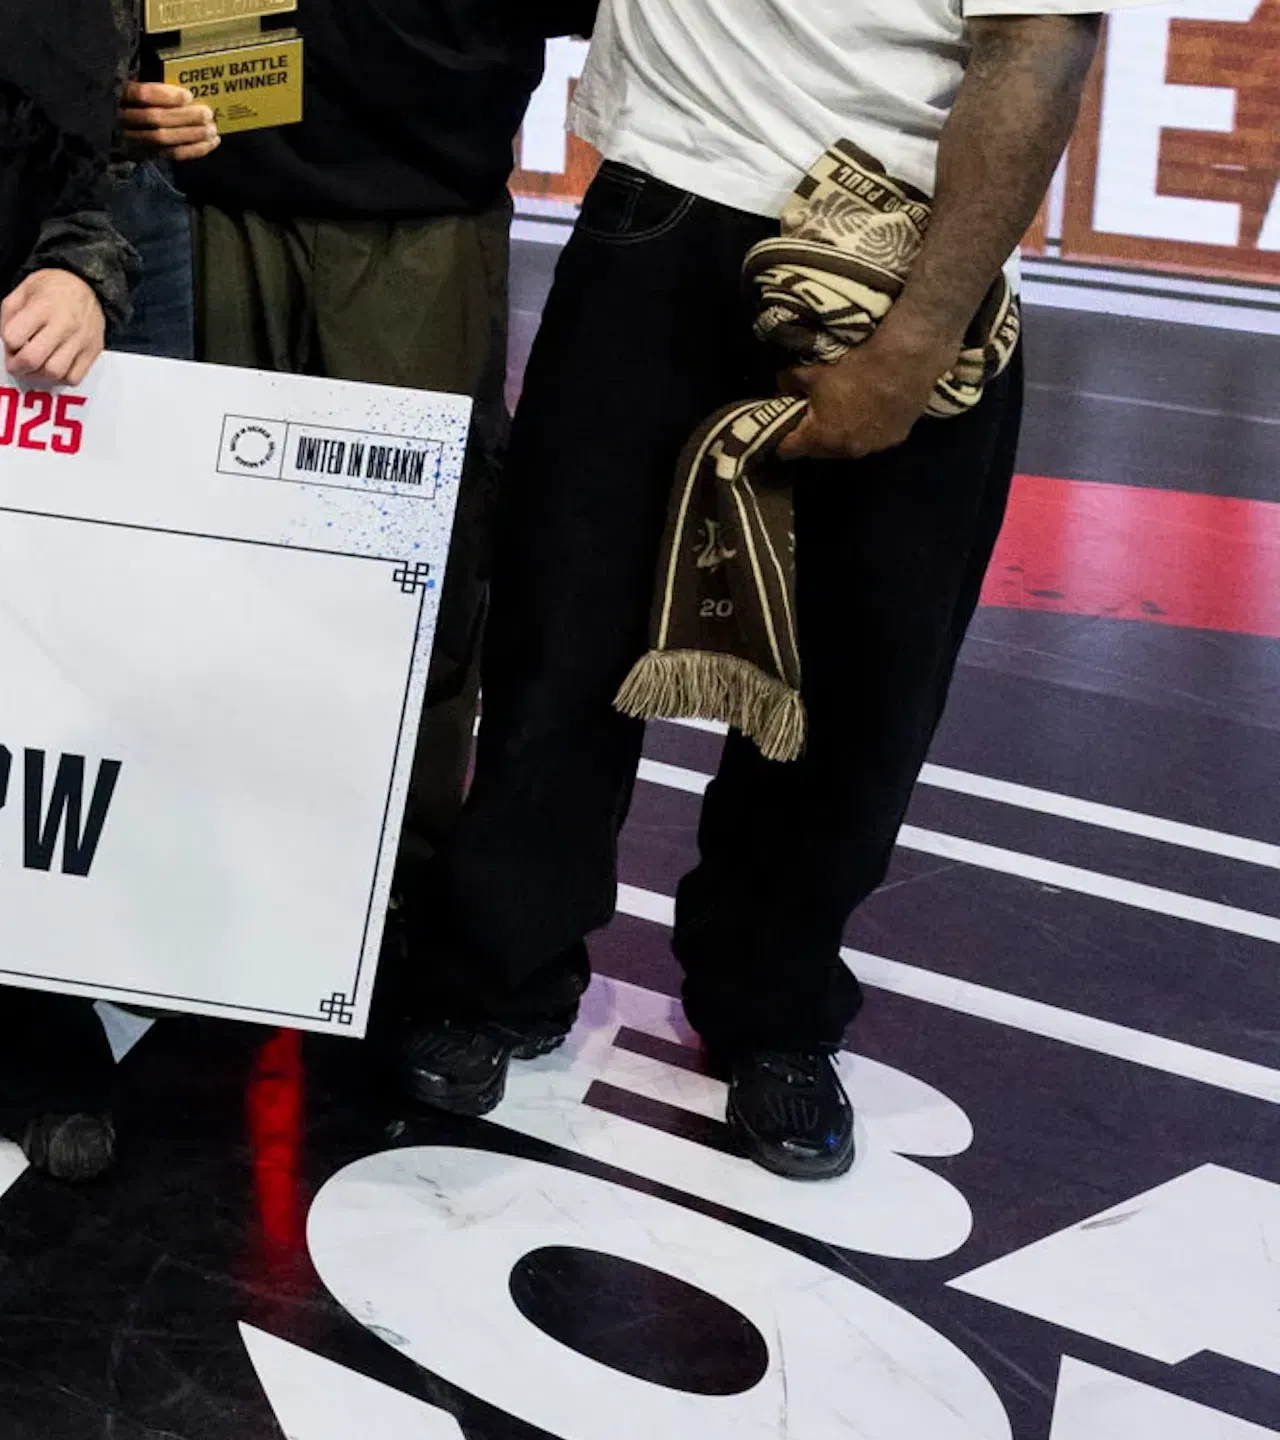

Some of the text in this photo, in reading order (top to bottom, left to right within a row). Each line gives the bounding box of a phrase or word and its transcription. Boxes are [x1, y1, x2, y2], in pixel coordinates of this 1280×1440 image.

[178, 55, 288, 85] CREW BATTLE
[191, 71, 288, 100] 025 WINNER
[295, 436, 346, 474] UNITED
[347, 442, 365, 476] IN
